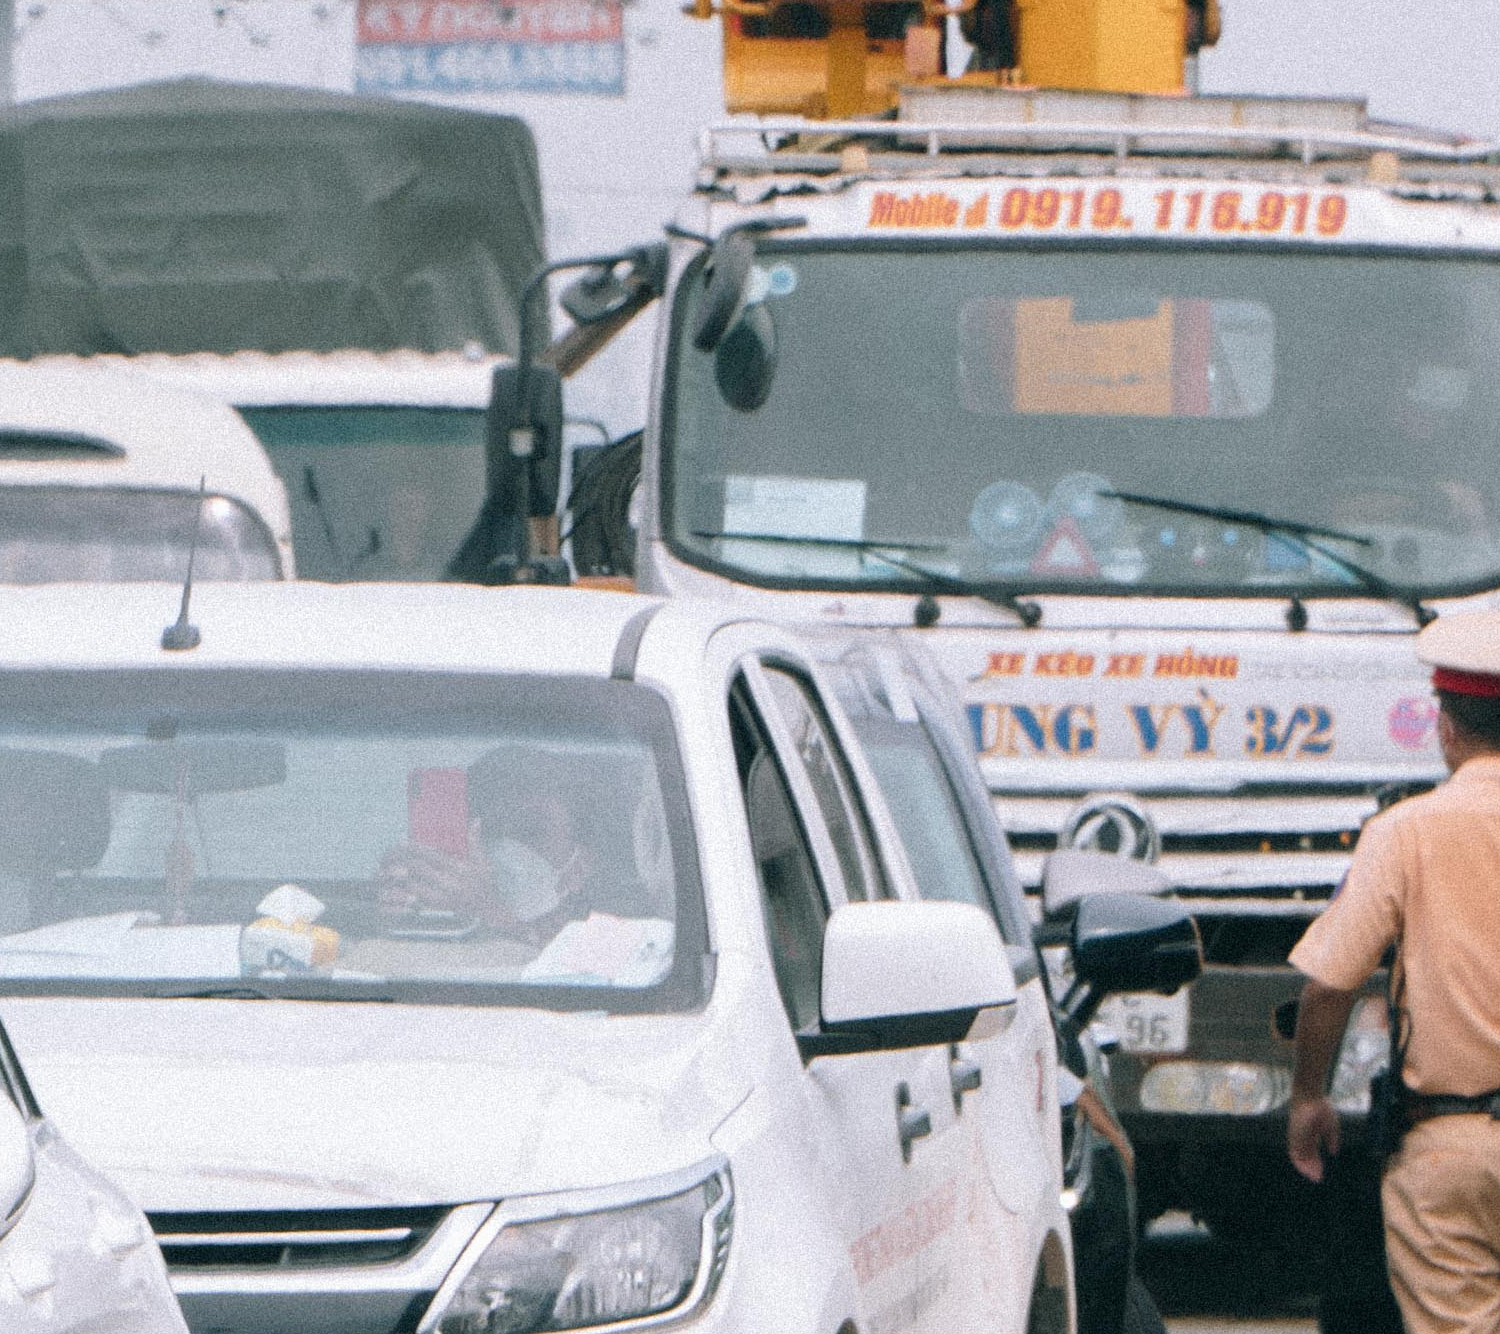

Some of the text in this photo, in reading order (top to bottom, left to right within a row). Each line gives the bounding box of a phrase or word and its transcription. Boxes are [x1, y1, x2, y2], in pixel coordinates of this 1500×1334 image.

[868, 186, 1349, 237] Mobile 0919. 116.919
[1103, 652, 1147, 677] XE
[1244, 701, 1336, 760] 3/2
